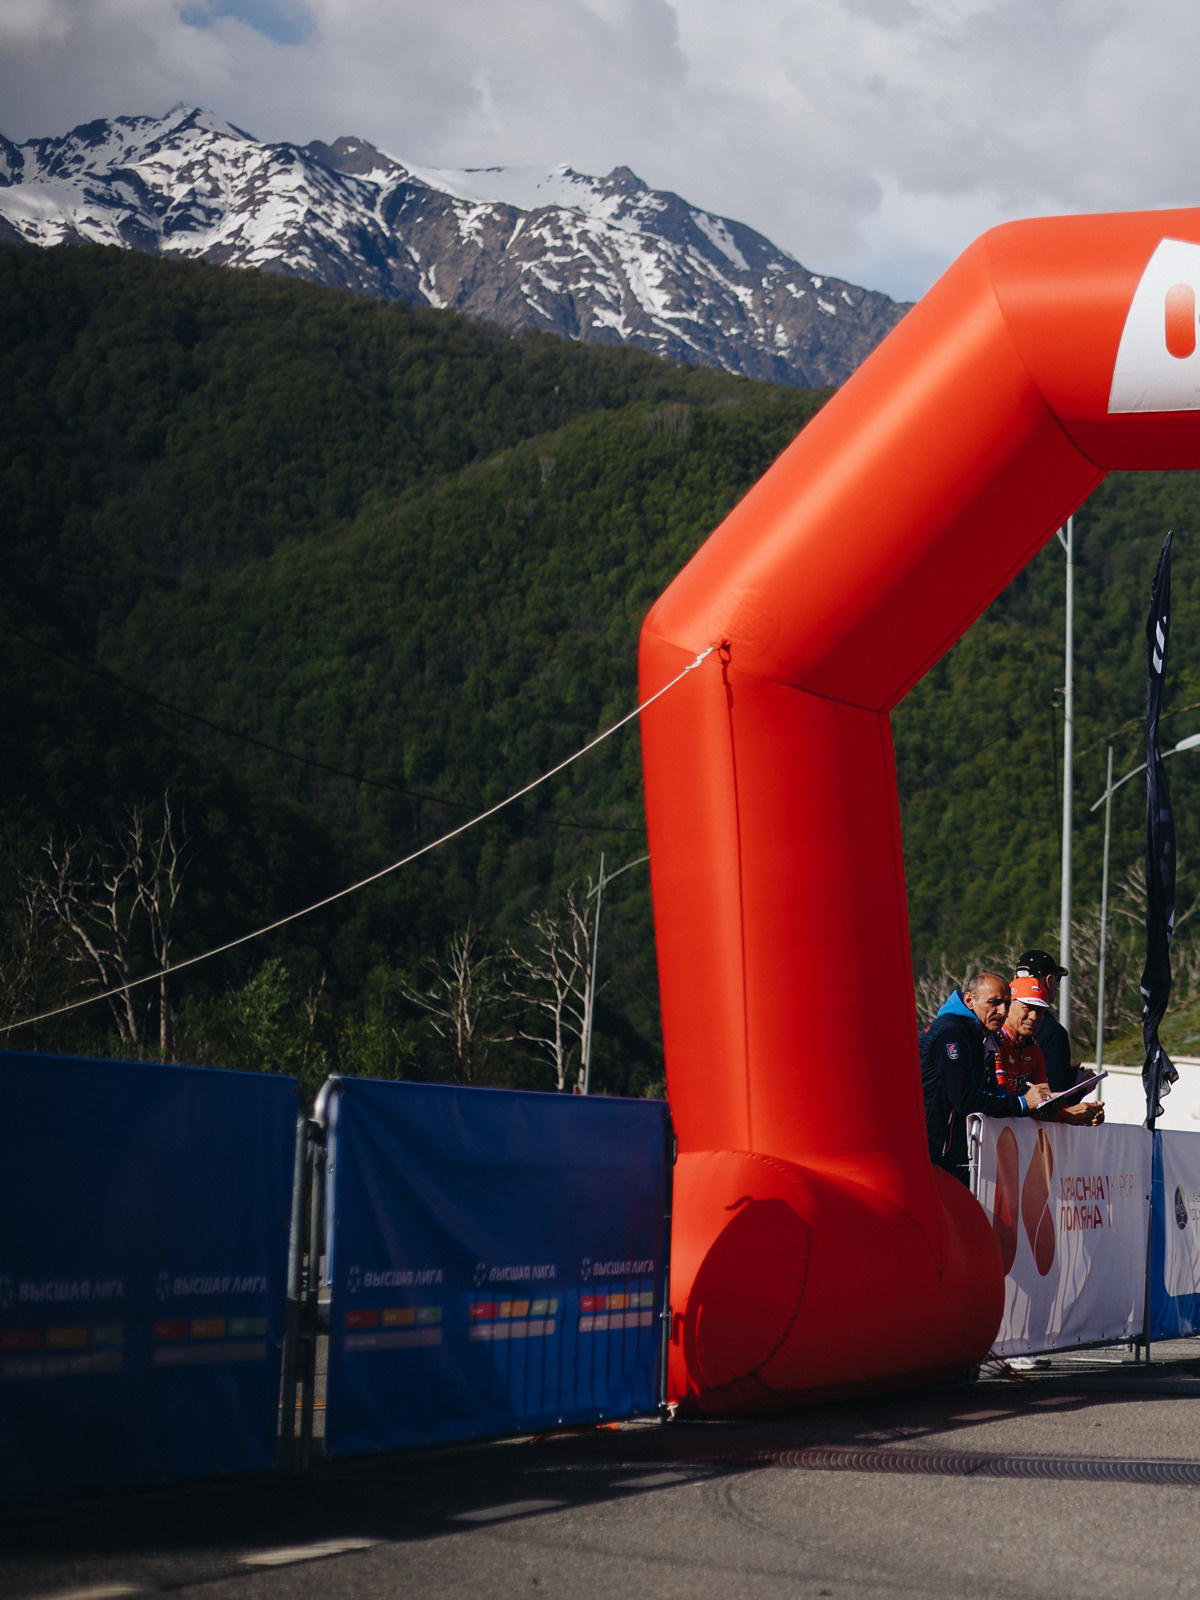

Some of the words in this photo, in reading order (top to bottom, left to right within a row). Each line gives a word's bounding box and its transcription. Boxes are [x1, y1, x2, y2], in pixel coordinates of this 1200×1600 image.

[1060, 1175, 1105, 1202] КРАСНАЯ
[1060, 1204, 1104, 1231] ПОЛЯНА
[363, 1270, 413, 1288] ВЫСШАЯ
[414, 1269, 442, 1286] ЛИГА
[488, 1266, 530, 1282] ВЫСШАЯ
[531, 1264, 556, 1280] ЛИГА
